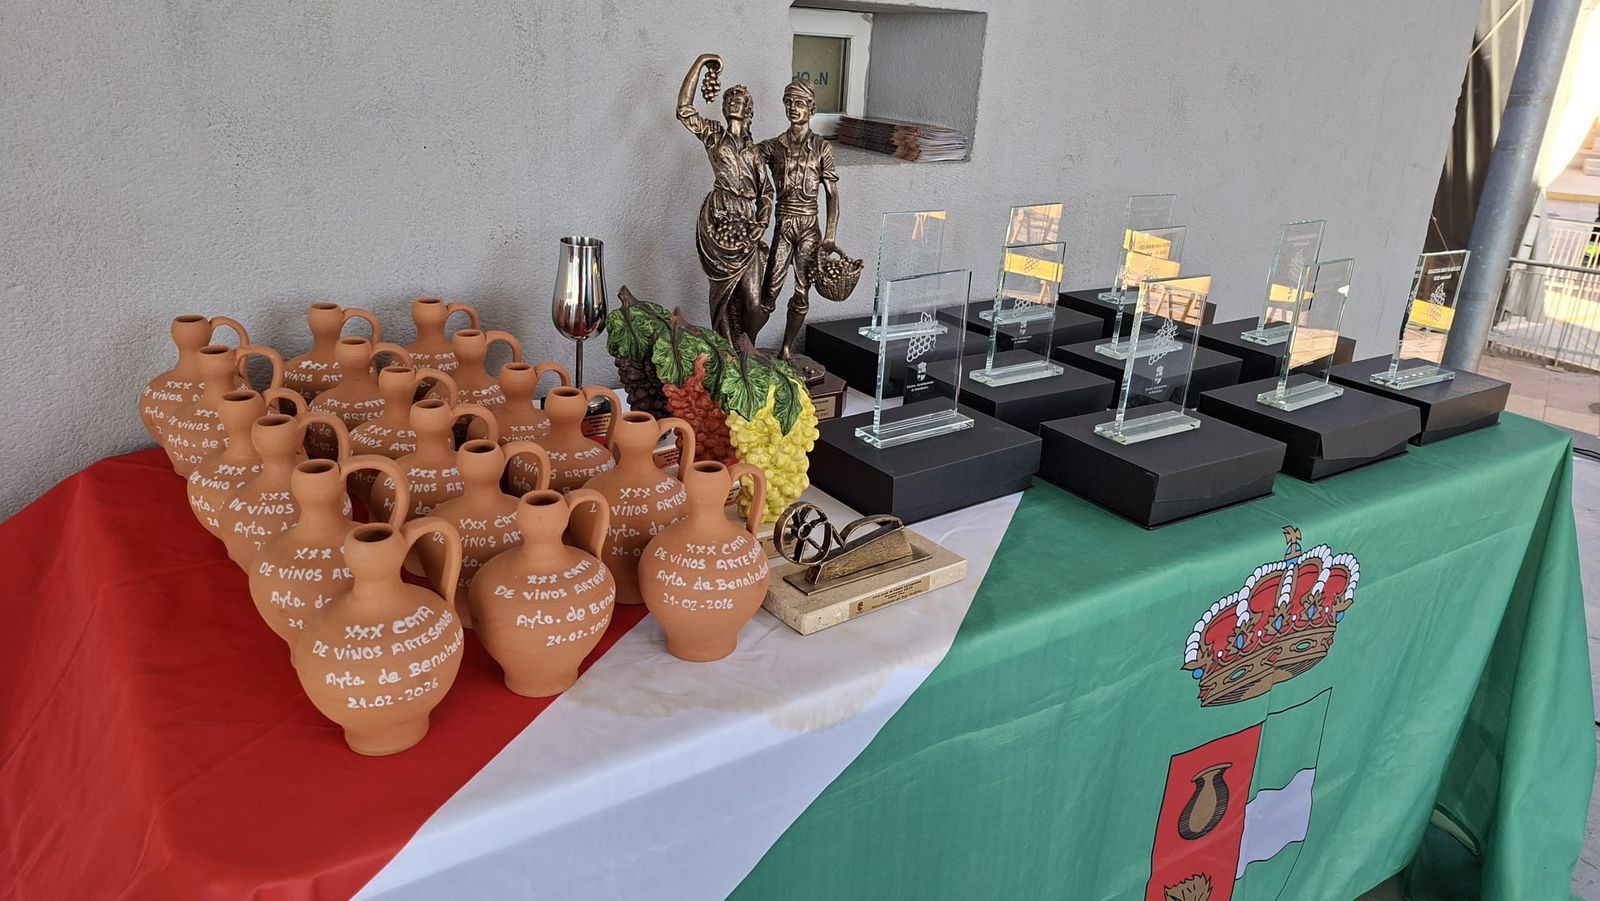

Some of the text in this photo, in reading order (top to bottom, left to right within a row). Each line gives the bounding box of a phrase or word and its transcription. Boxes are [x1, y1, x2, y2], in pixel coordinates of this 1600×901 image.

[686, 543, 717, 556] XXX
[344, 623, 385, 641] XXX
[378, 668, 402, 686] de
